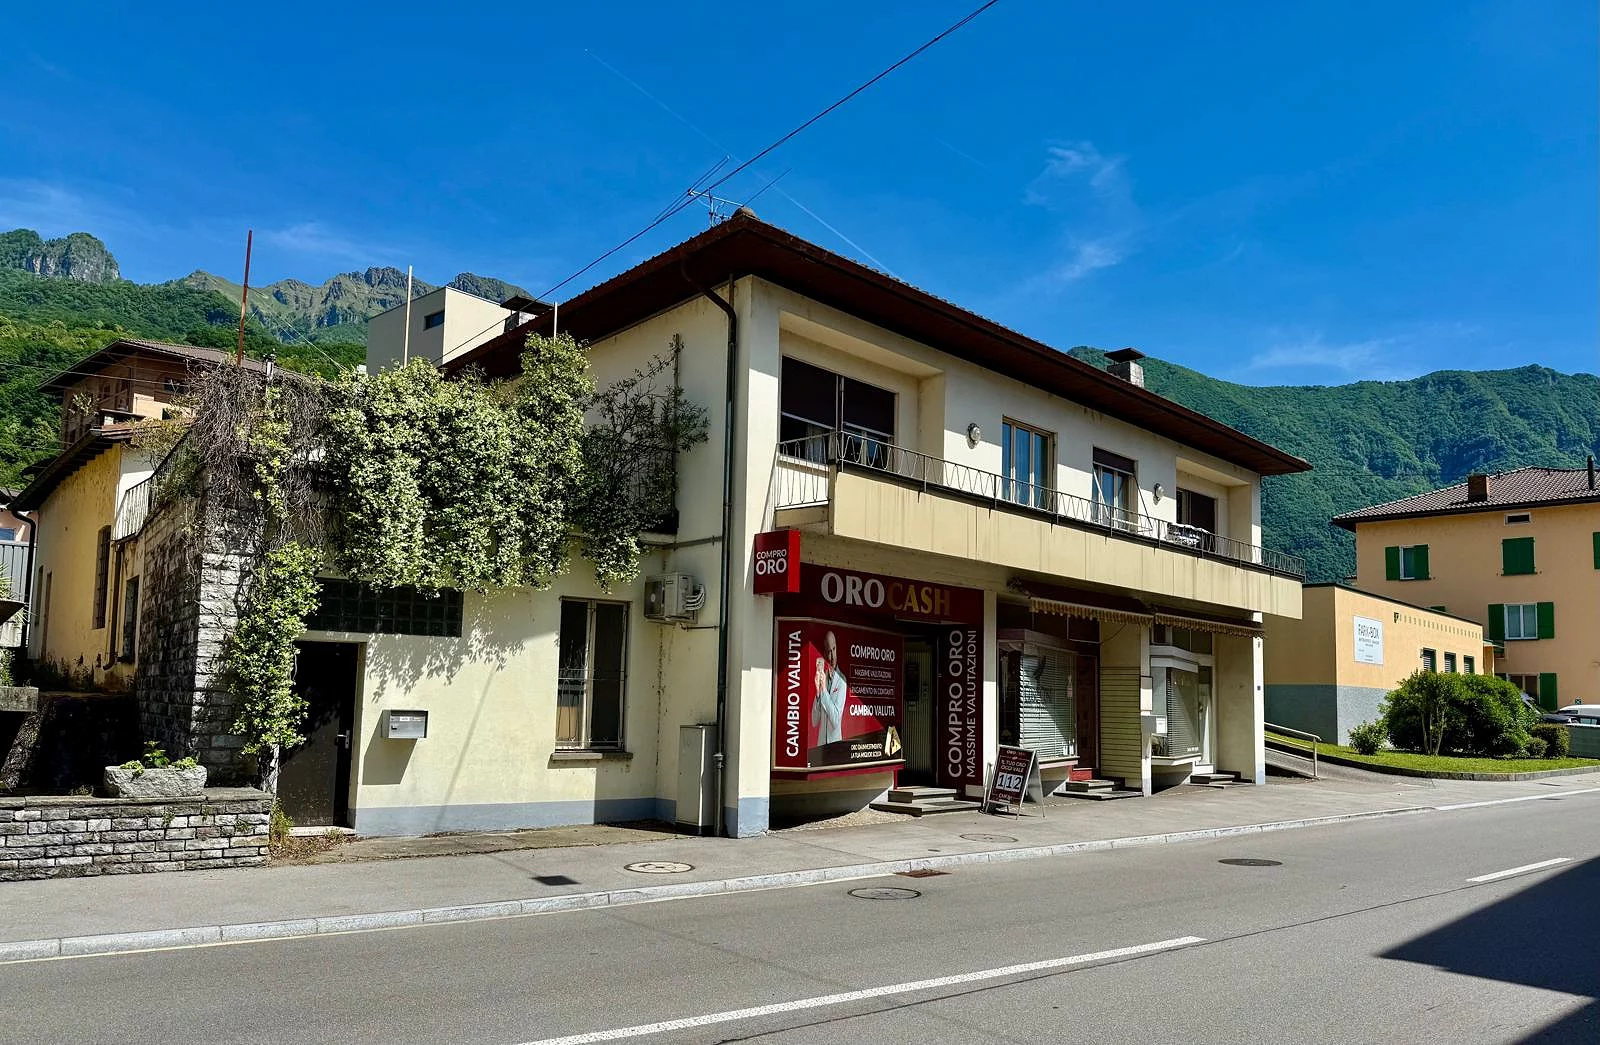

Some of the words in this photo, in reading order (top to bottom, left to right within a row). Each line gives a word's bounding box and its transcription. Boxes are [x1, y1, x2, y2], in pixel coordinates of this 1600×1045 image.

[756, 549, 787, 560] COMPRO
[756, 558, 787, 575] ORO
[821, 572, 885, 608] ORO
[887, 582, 951, 616] CASH
[787, 630, 802, 690] VALUTA
[850, 644, 880, 660] COMPRO
[880, 648, 896, 662] ORO
[949, 630, 963, 677] ORO
[967, 630, 977, 715] VALUTAZIONI
[786, 693, 800, 757] CAMBIO
[849, 704, 874, 716] CAMBIO
[874, 705, 896, 717] VALUTA
[948, 682, 963, 778] COMPRO
[966, 717, 976, 778] MASSIME
[998, 774, 1021, 790] 112
